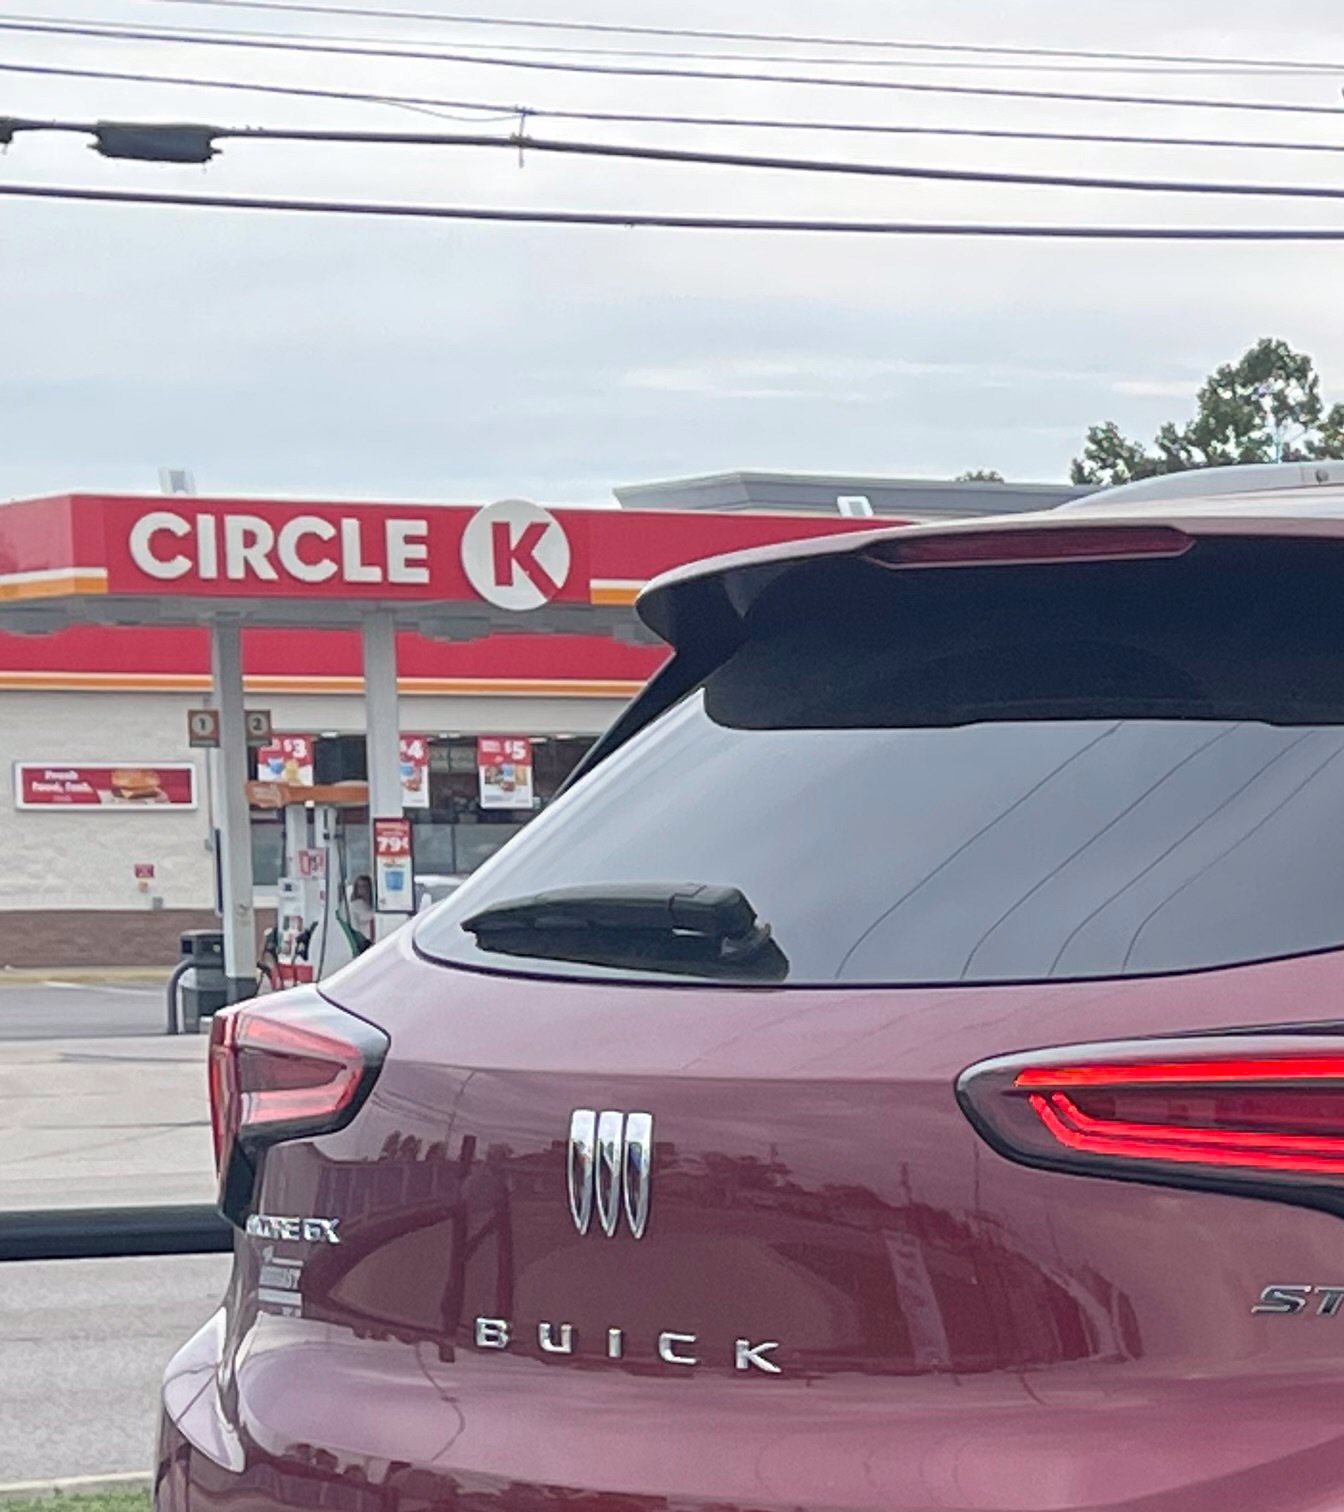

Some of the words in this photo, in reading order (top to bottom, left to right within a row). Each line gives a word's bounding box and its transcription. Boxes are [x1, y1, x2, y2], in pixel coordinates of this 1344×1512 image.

[129, 511, 431, 584] CIRCLE
[491, 521, 563, 600] K
[251, 717, 263, 732] 2
[475, 1317, 783, 1374] BUICK
